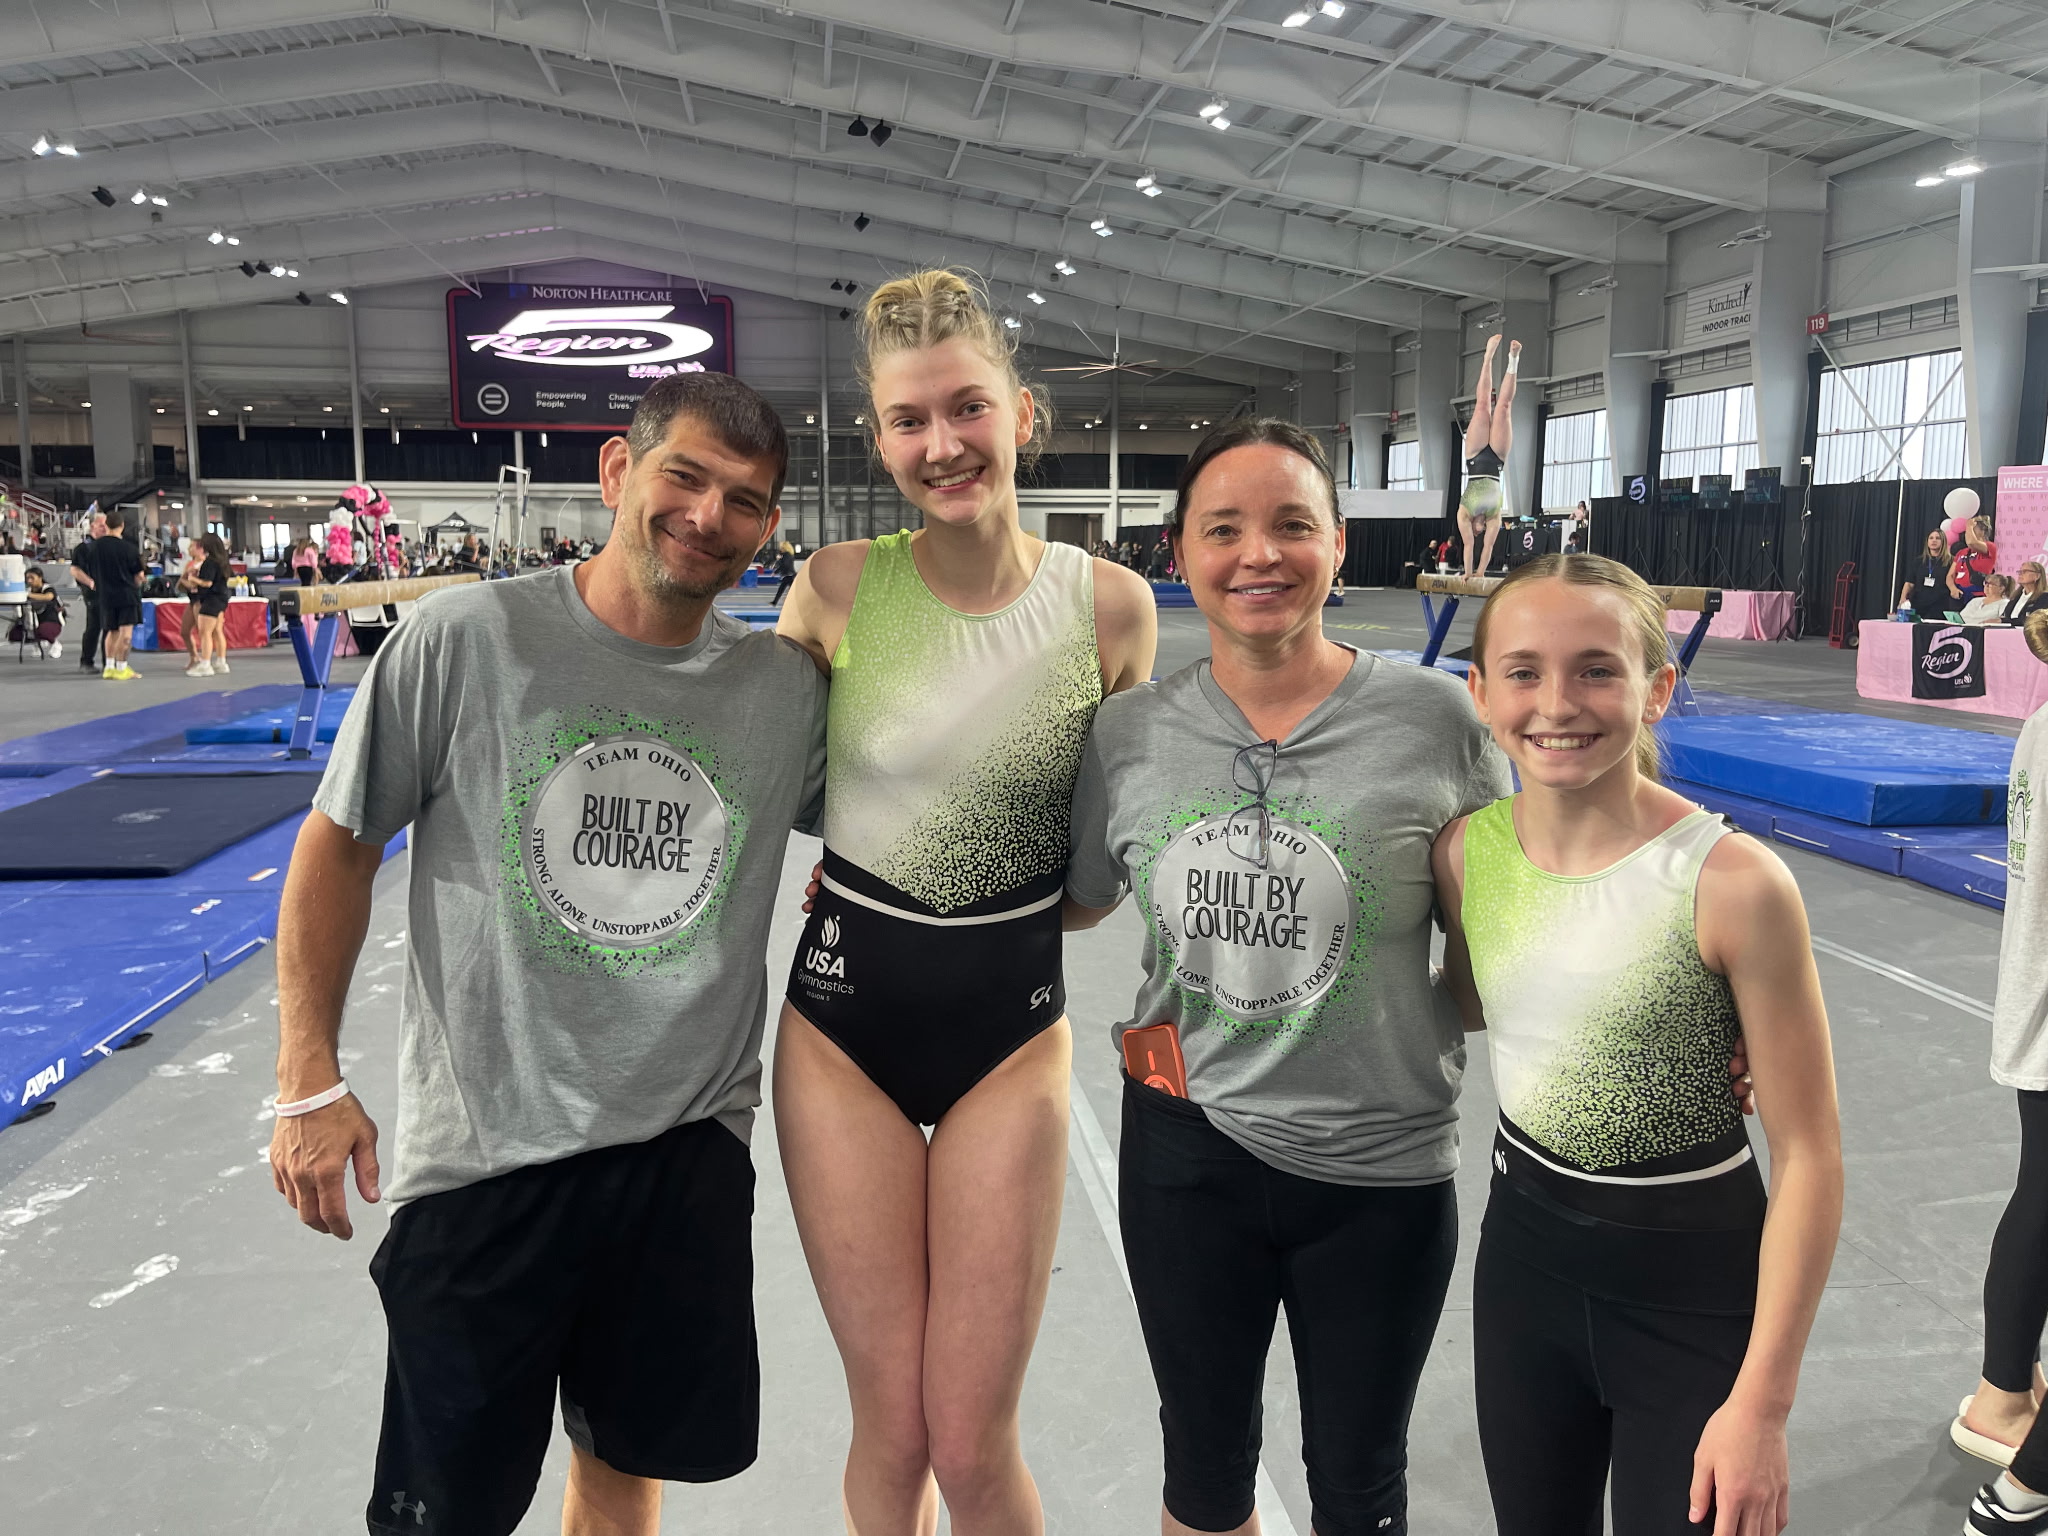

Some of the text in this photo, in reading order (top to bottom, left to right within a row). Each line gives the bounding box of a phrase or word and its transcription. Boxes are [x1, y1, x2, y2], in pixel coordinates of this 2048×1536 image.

[1707, 290, 1743, 314] Kindred
[1703, 319, 1729, 333] INDOOR
[1811, 317, 1825, 330] 119
[467, 333, 653, 356] Region
[536, 391, 643, 403] Empowering Changin
[536, 400, 632, 411] People. Lives.
[2003, 476, 2043, 489] WHERE
[1921, 652, 1961, 672] Region
[1927, 626, 1973, 679] 5
[583, 747, 692, 783] TEAM OHIO
[581, 793, 691, 837] BUILT BY
[1191, 824, 1250, 847] TEAM
[572, 829, 693, 873] COURAGE
[532, 827, 553, 885] STRONG
[592, 909, 683, 935] UNSTOPPABLE
[1187, 868, 1305, 914] BUILT BY
[1182, 905, 1308, 951] COURAGE
[805, 946, 845, 979] USA
[797, 968, 855, 995] Gymnastics
[1215, 983, 1303, 1011] UNSTOPPABLE
